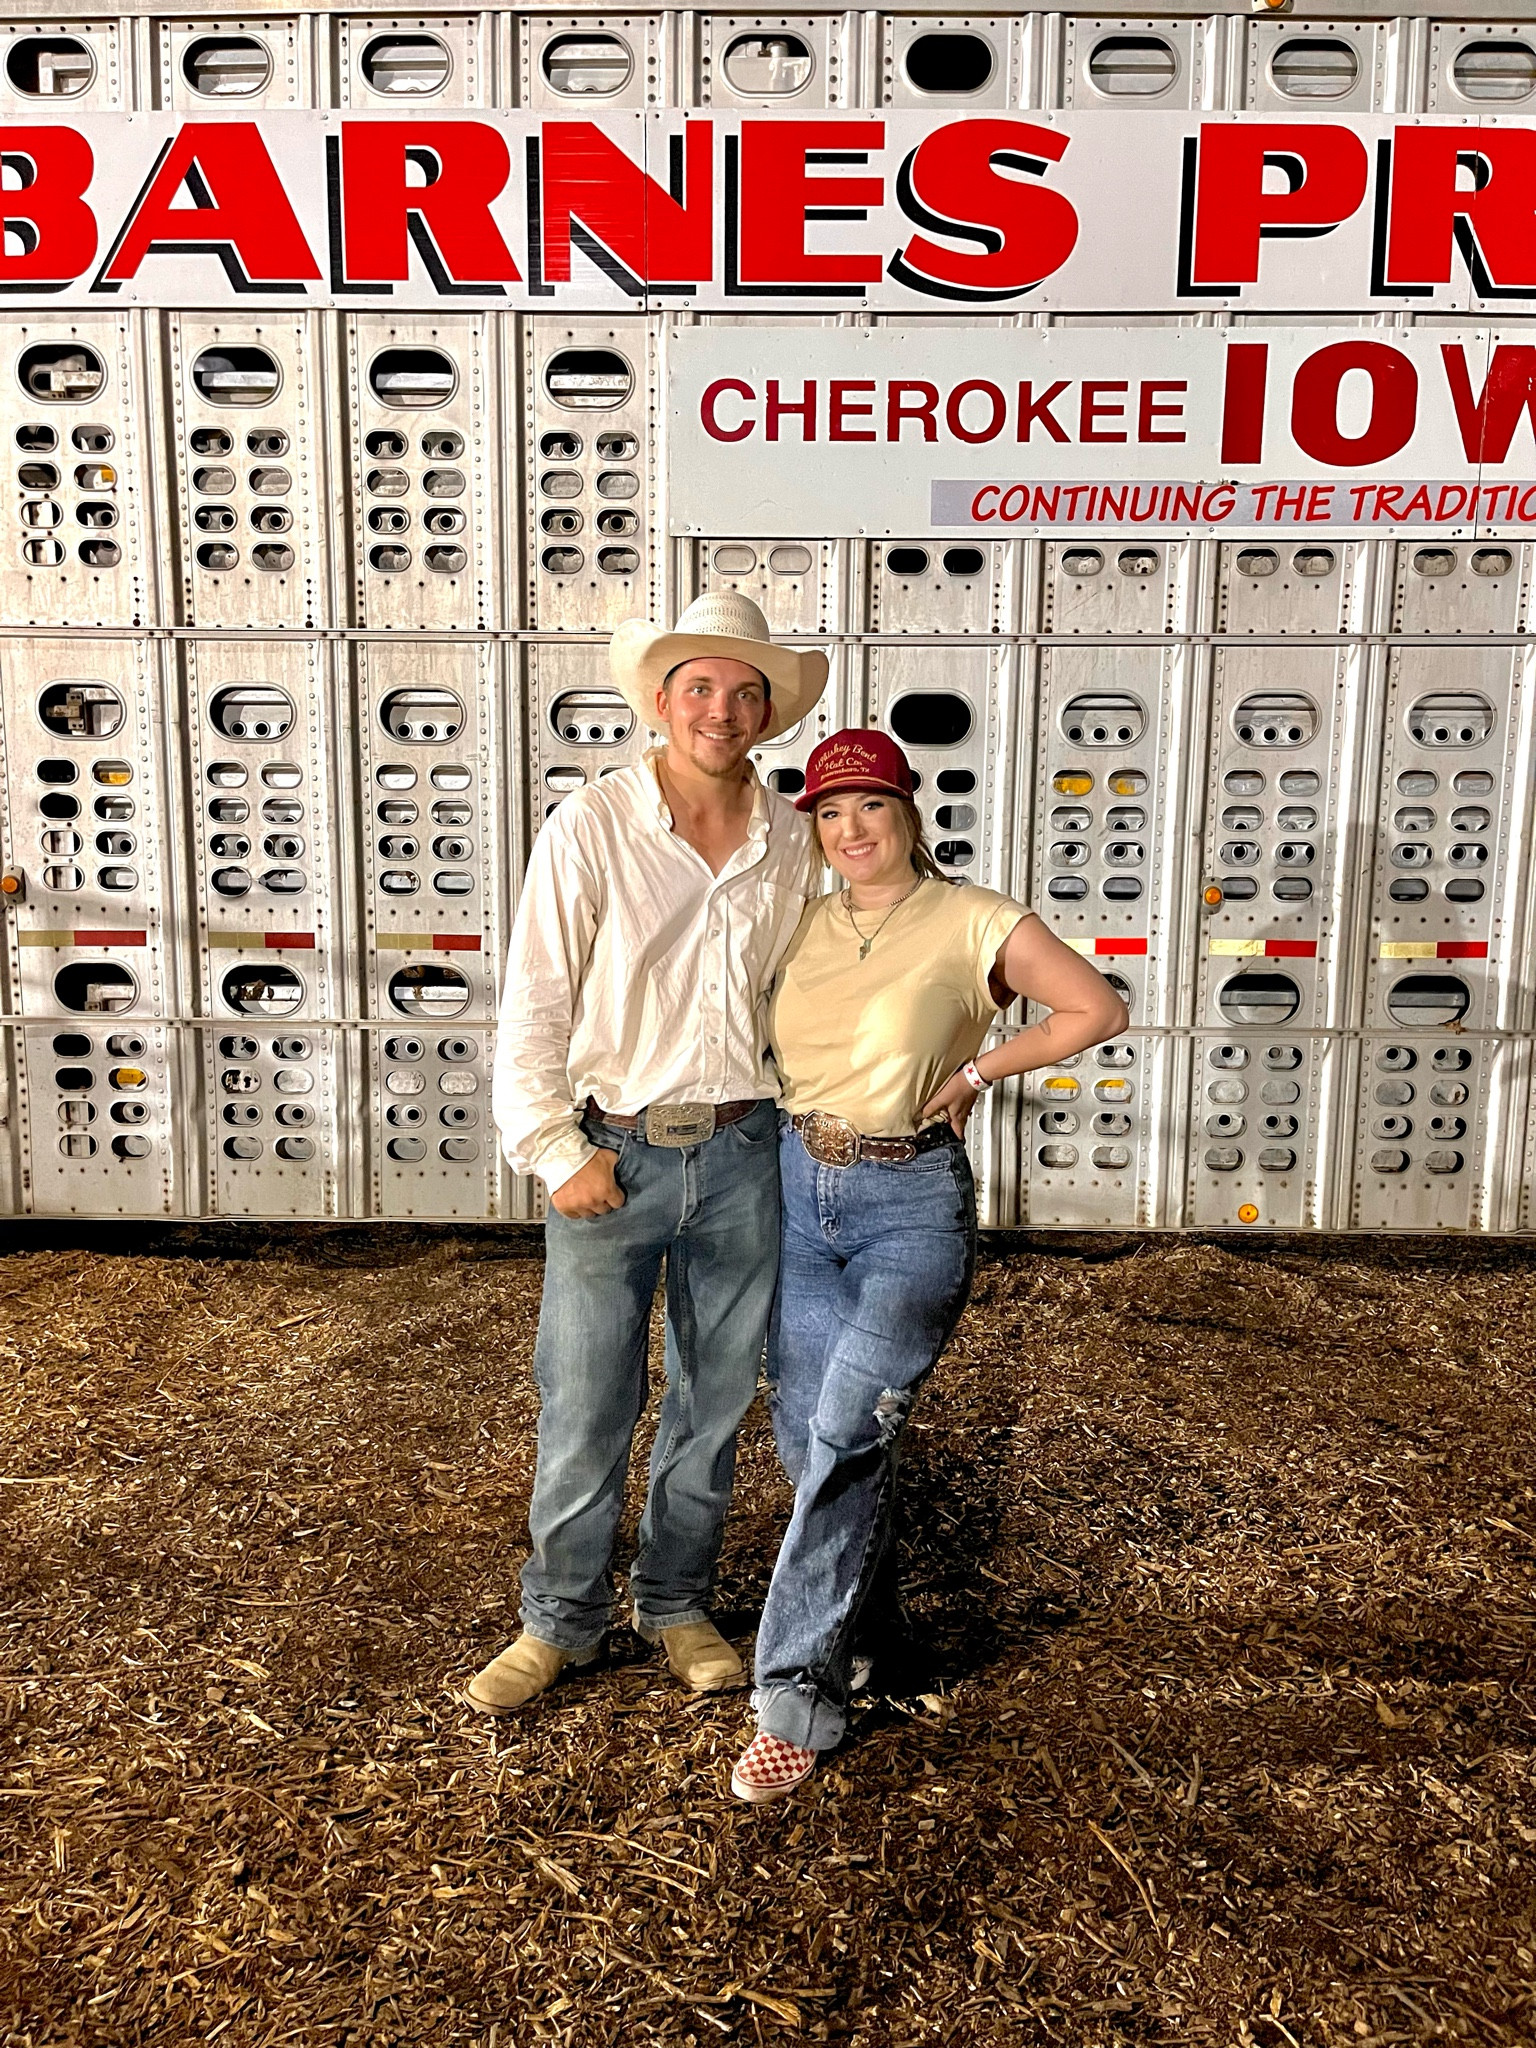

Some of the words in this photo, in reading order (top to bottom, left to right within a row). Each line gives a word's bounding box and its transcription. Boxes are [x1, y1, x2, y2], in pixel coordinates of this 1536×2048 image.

[0, 118, 1080, 301] BARNES
[1177, 122, 1536, 298] PR
[700, 378, 1188, 444] CHEROKEE
[1220, 340, 1536, 467] IOW
[971, 485, 1235, 522] CONTINUING
[1250, 485, 1335, 521] THE
[815, 743, 850, 772] Whiskey
[852, 744, 877, 763] Bent
[824, 758, 845, 772] Hat
